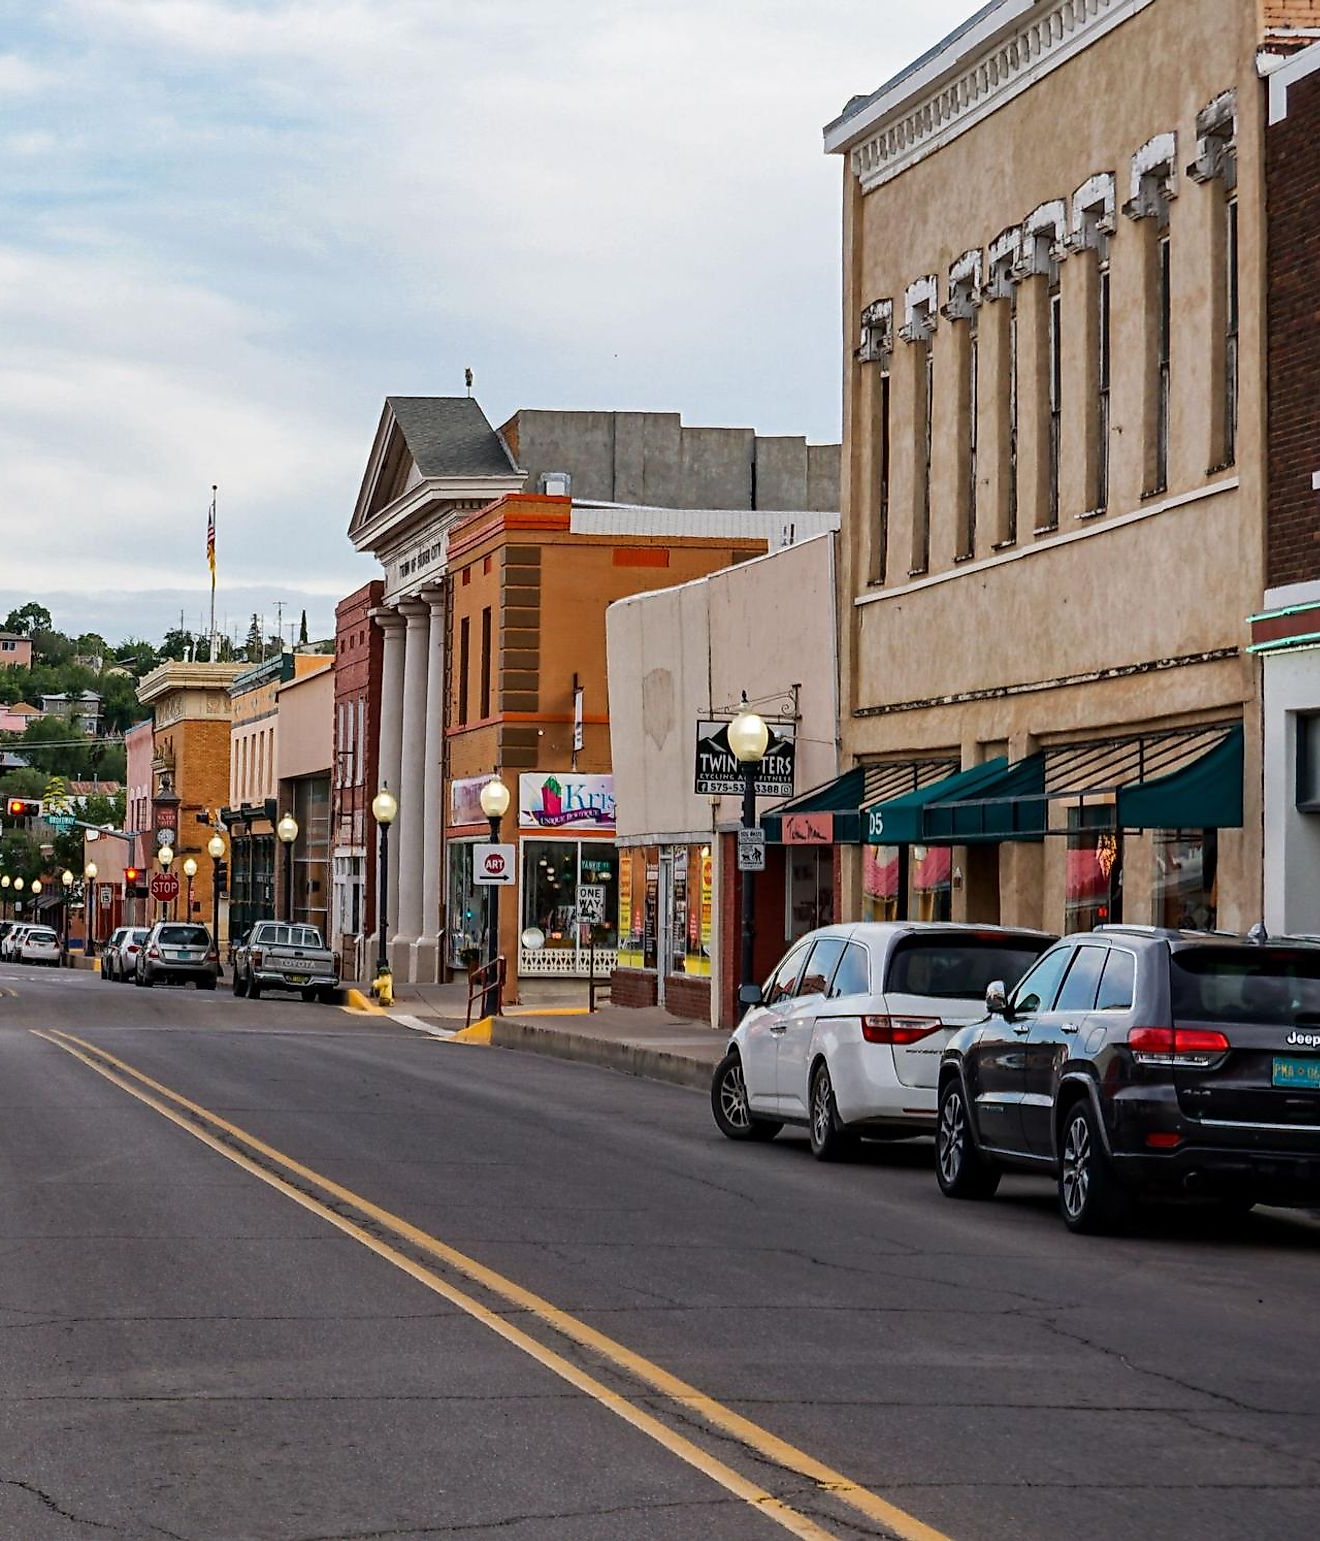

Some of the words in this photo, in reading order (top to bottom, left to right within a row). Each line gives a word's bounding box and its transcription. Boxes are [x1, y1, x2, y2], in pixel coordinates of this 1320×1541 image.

[700, 753, 738, 773] TWIN
[700, 773, 735, 781] CYCLING
[759, 775, 792, 783] FITNESS
[540, 813, 566, 826] UNIQUE
[566, 808, 601, 821] BOUTIQUE
[485, 859, 504, 869] ART
[152, 881, 178, 894] STOP
[580, 888, 601, 898] ONE
[579, 899, 601, 908] WAY
[280, 958, 316, 969] TOYOTA
[1287, 1031, 1320, 1047] Jeep
